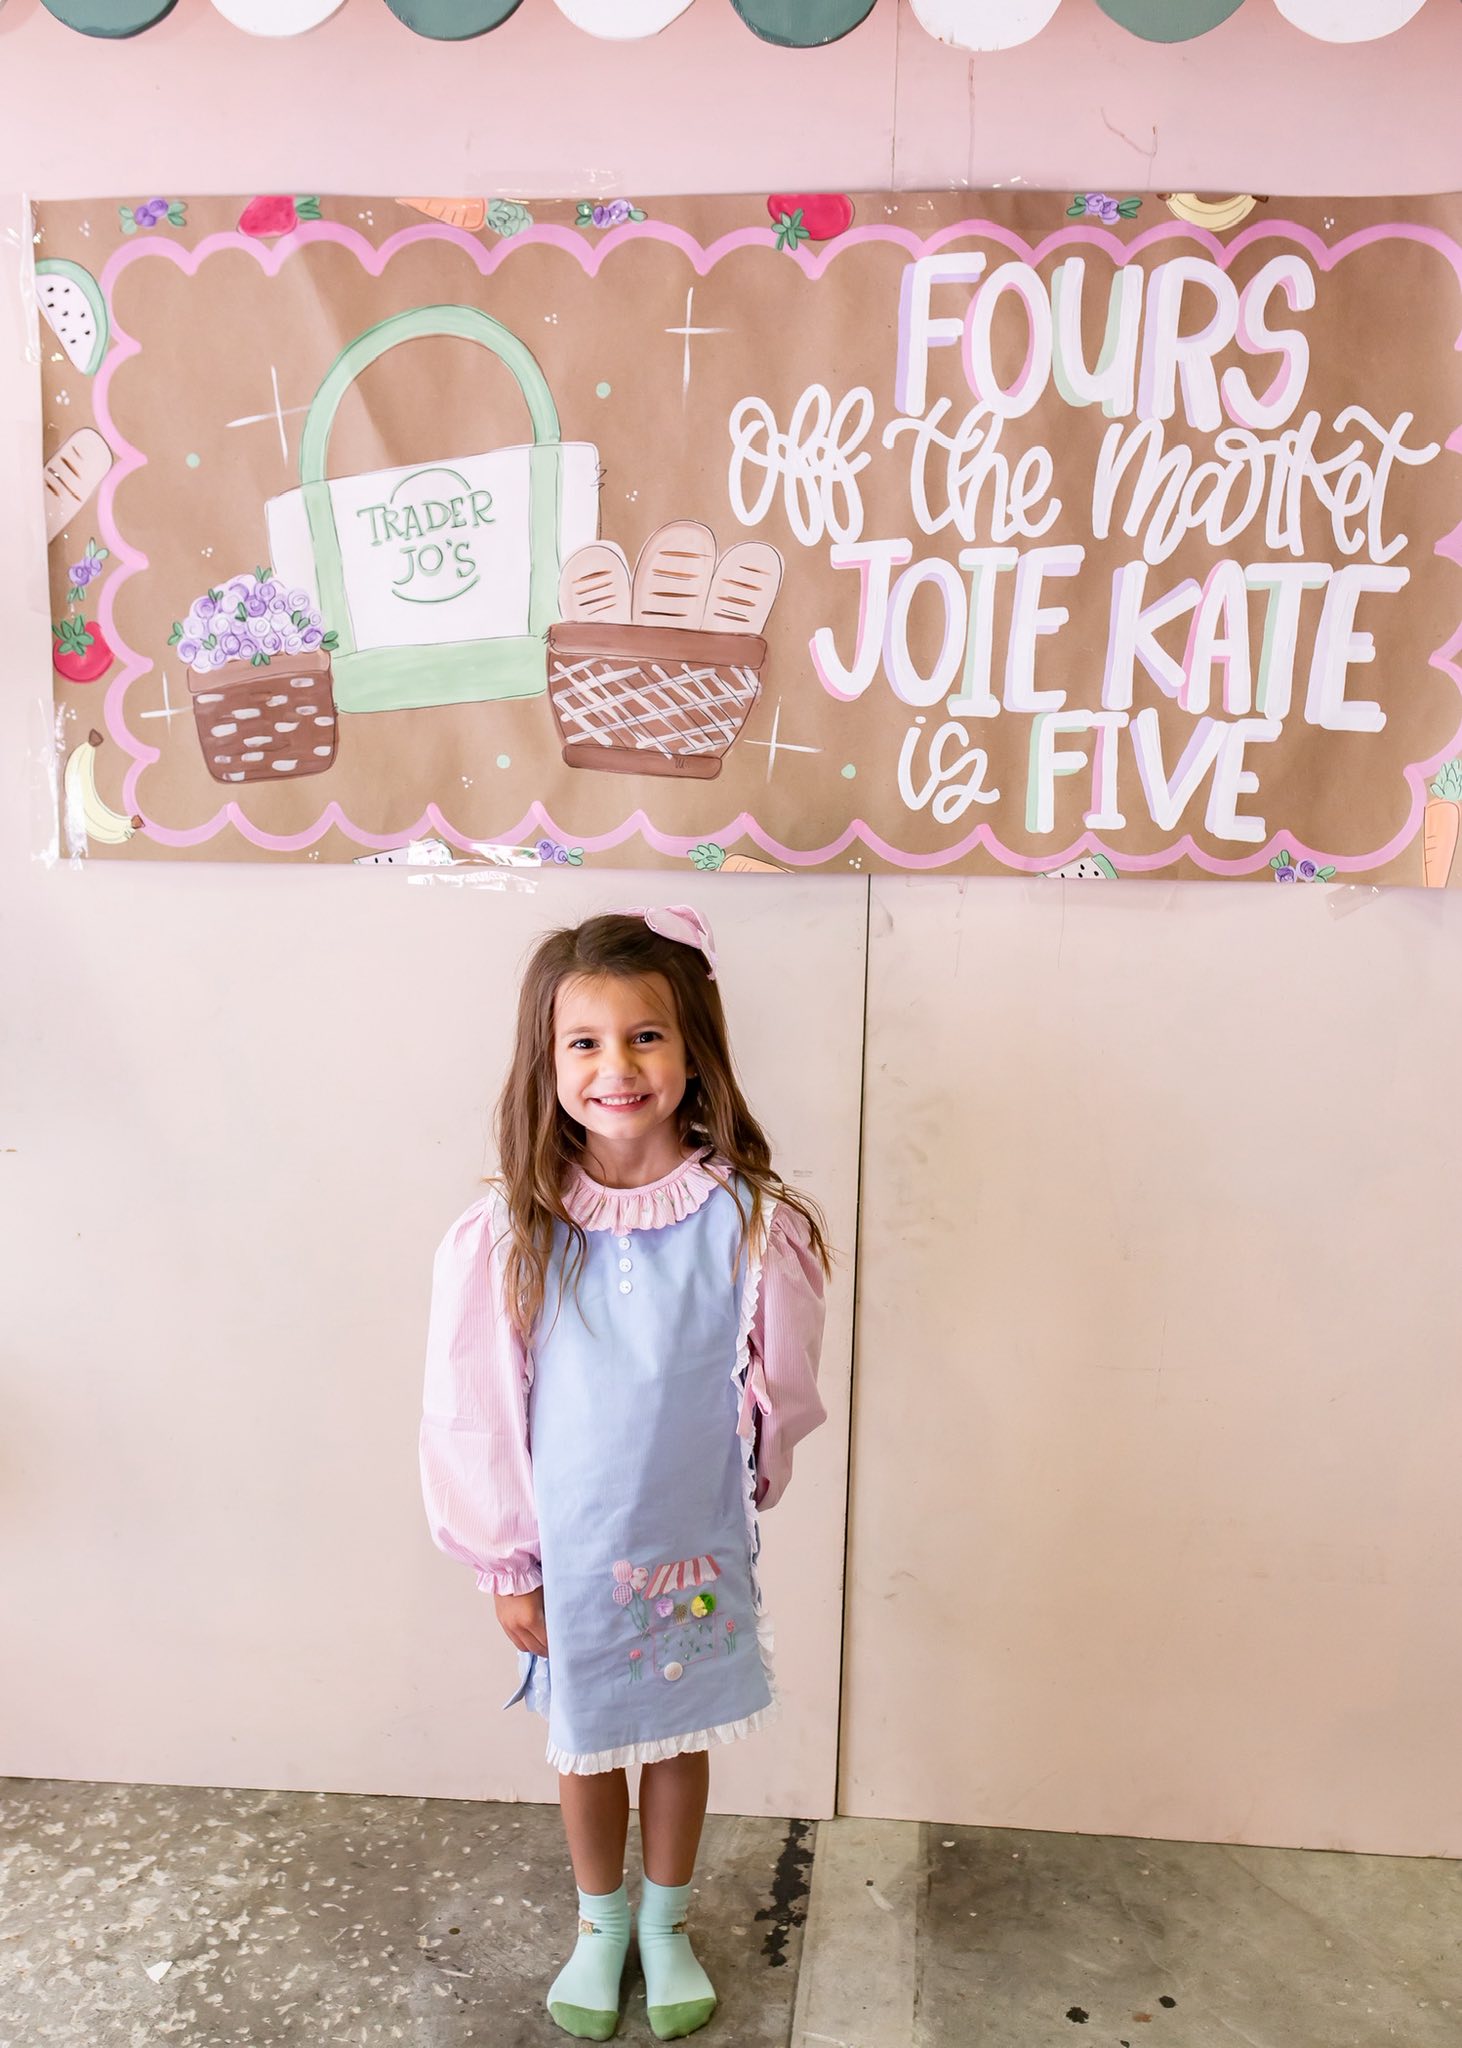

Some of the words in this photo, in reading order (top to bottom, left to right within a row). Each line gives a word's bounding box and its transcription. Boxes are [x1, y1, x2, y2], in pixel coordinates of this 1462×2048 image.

[895, 251, 1316, 431] FOURS
[356, 490, 496, 546] TRADER
[392, 539, 477, 586] JO'S
[809, 538, 1086, 718] JOIE
[1101, 559, 1410, 732] KATE
[898, 716, 1000, 825] is
[1025, 708, 1283, 843] FIVE
